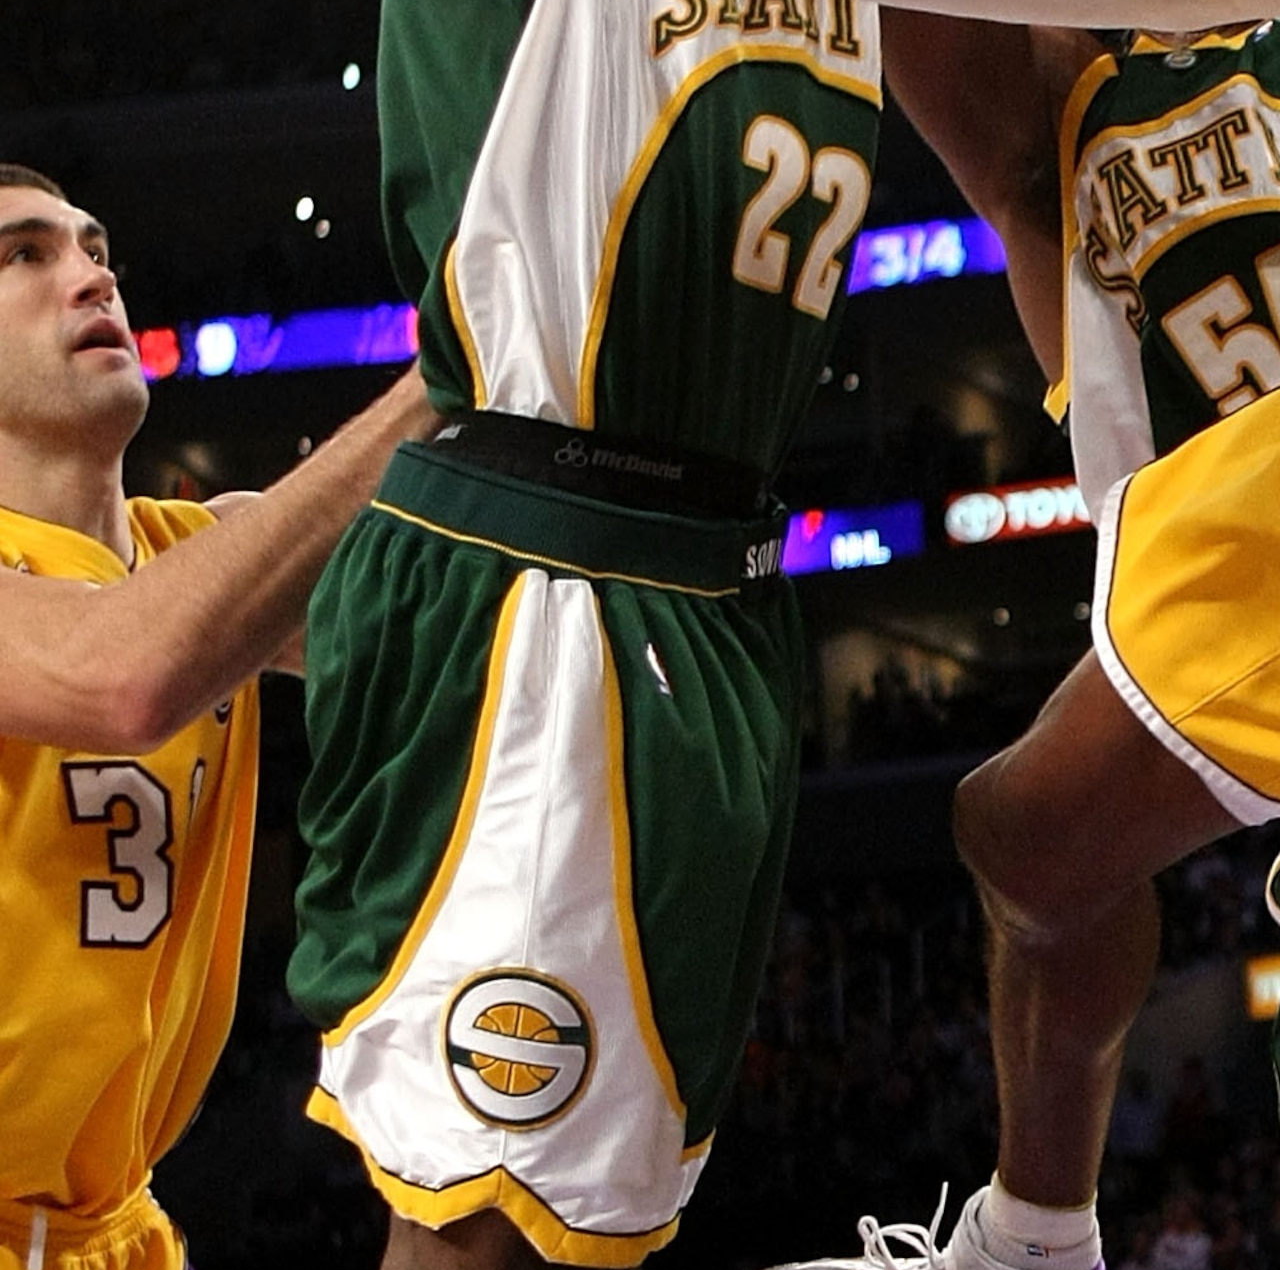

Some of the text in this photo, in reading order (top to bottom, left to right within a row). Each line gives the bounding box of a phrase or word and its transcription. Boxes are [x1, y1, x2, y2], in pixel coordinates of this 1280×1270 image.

[732, 114, 871, 320] 22
[870, 224, 967, 288] 3/4
[591, 448, 684, 481] McDavid
[61, 759, 206, 948] 3
